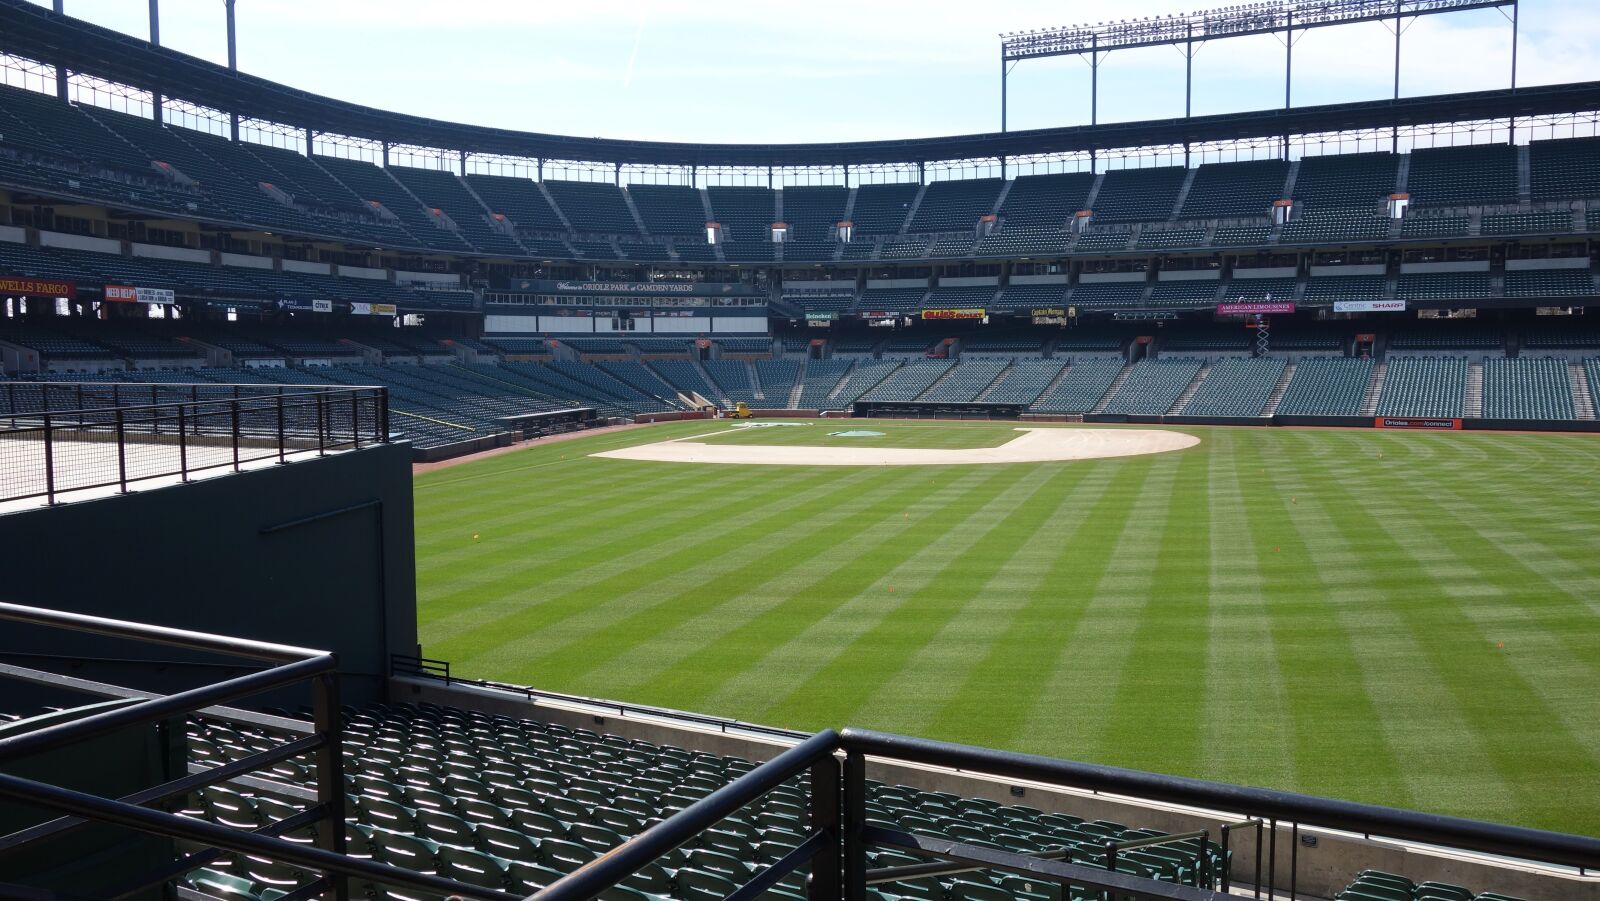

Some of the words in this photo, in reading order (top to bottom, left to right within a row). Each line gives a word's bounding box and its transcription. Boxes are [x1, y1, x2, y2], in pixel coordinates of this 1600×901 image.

[0, 281, 34, 292] WELLS
[36, 282, 69, 294] FARGO
[610, 284, 630, 292] PARK
[106, 287, 120, 297] NEED
[120, 289, 136, 299] HELP?
[1253, 302, 1290, 310] LIMOUSINES
